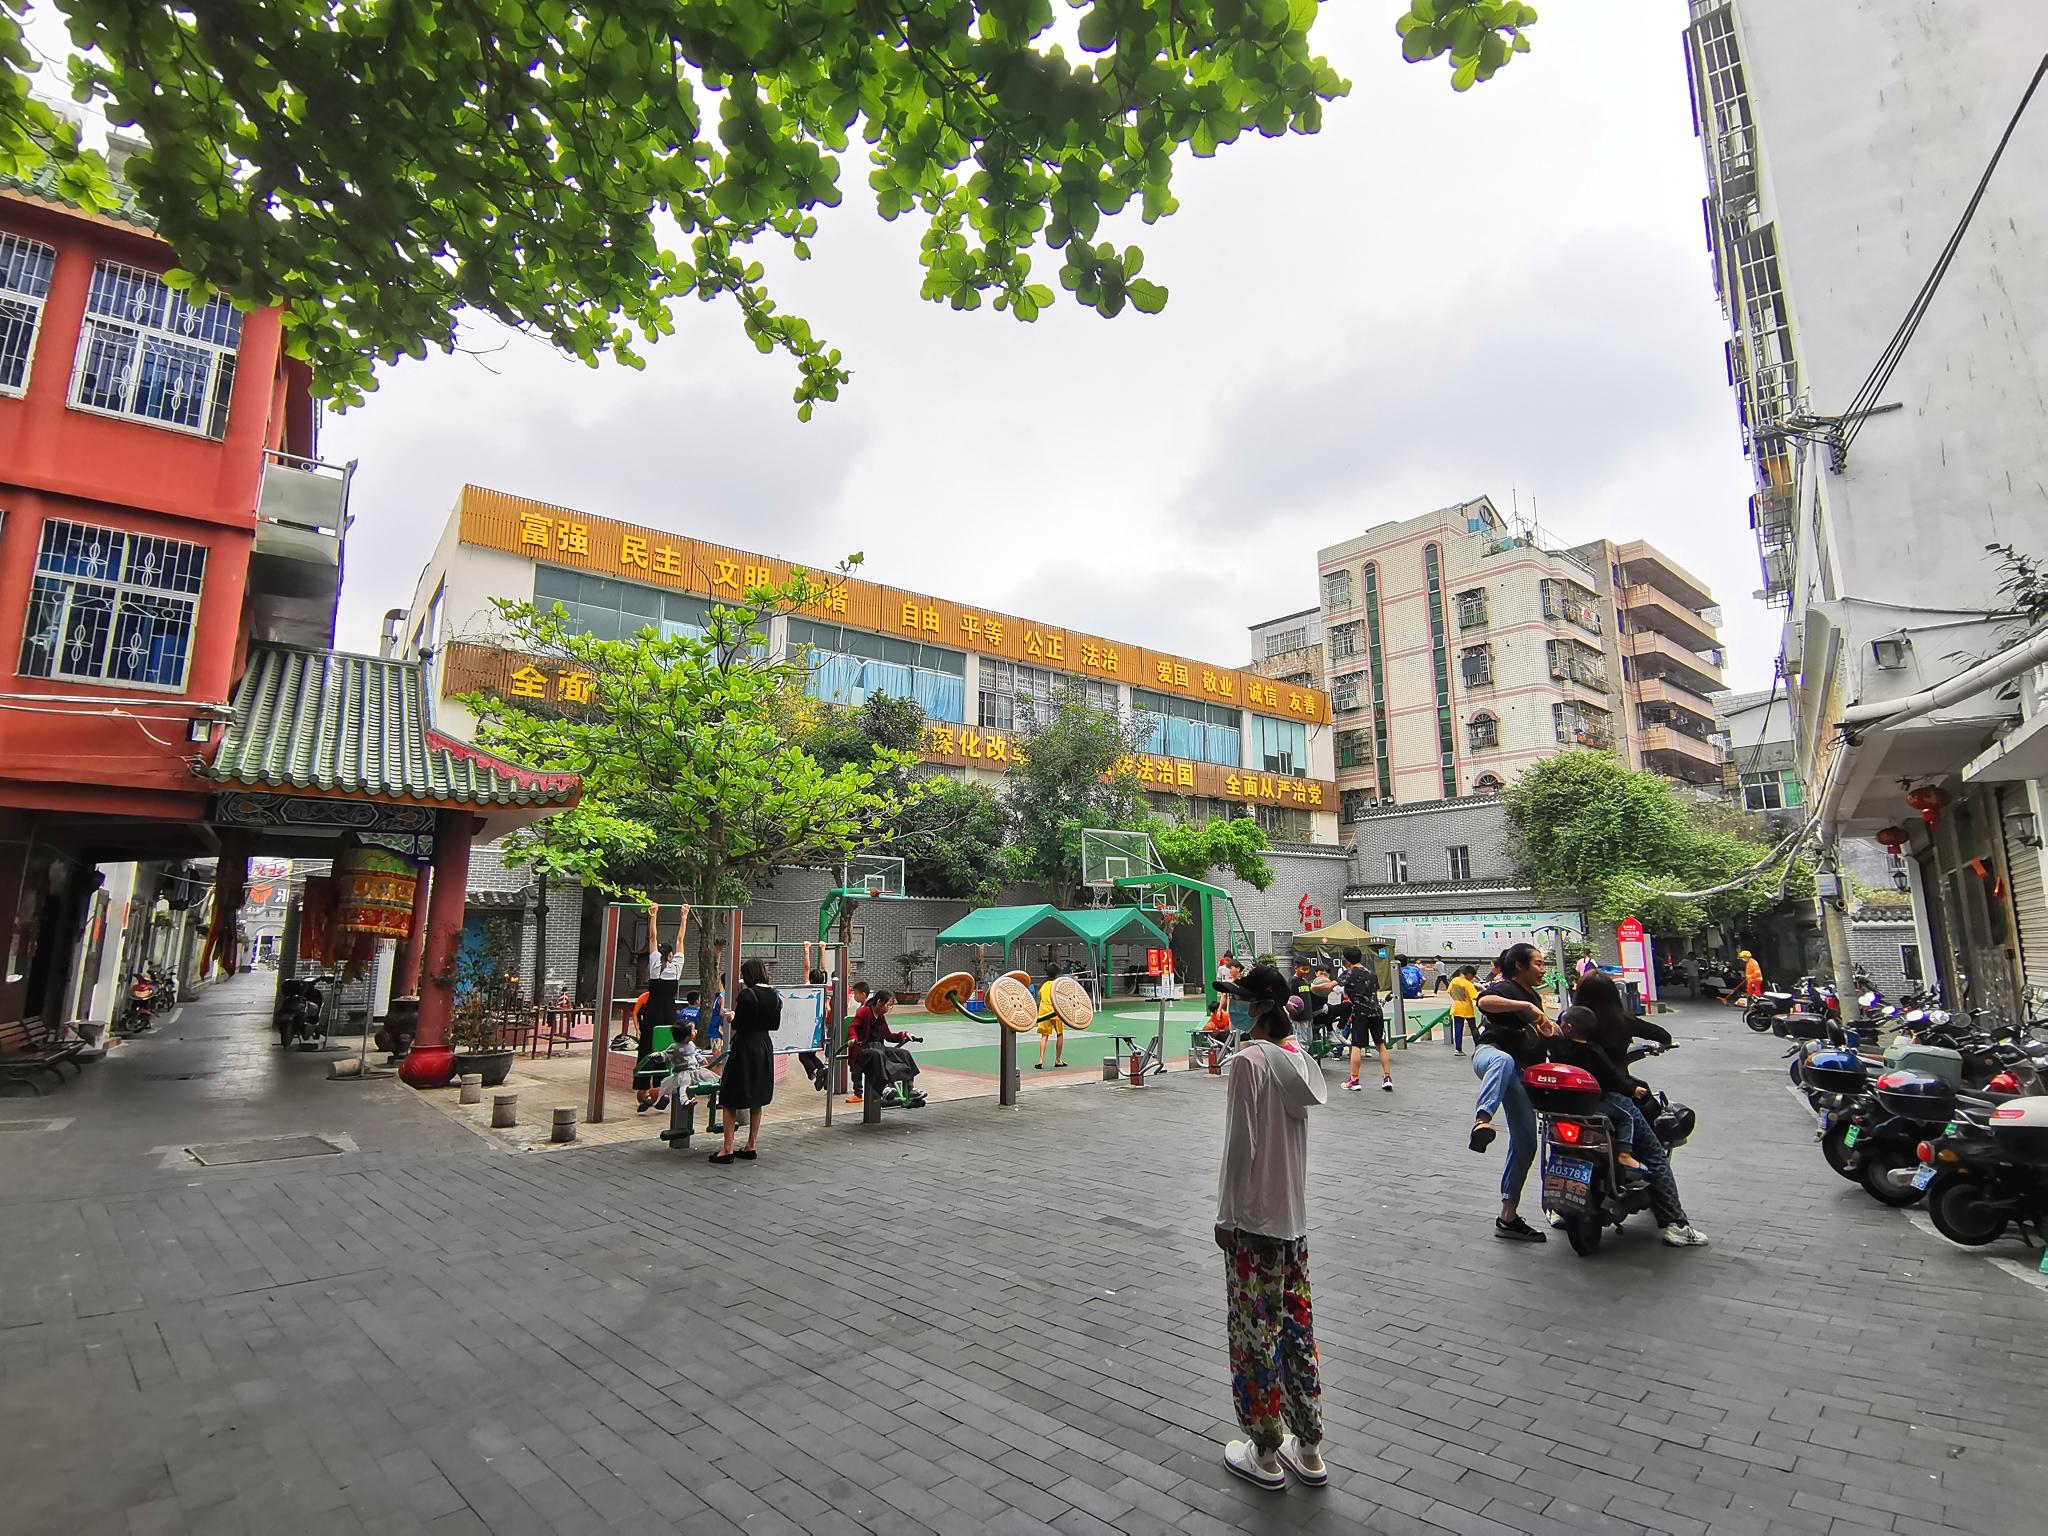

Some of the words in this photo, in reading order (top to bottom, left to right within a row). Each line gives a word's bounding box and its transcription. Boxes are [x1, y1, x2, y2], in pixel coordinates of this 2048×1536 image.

[520, 511, 589, 556] 富强
[620, 534, 682, 576] 民主
[713, 557, 772, 594] 文明
[901, 600, 940, 634] 自由
[960, 613, 1004, 647] 平等
[1024, 629, 1064, 661] 公正
[1081, 642, 1119, 673] 法治
[1156, 660, 1190, 688] 爱国
[1202, 669, 1234, 697] 敬业
[1248, 681, 1278, 707] 诚信
[1289, 689, 1316, 715] 友善
[511, 664, 589, 704] 全面
[1224, 771, 1323, 806] 全面从严治党
